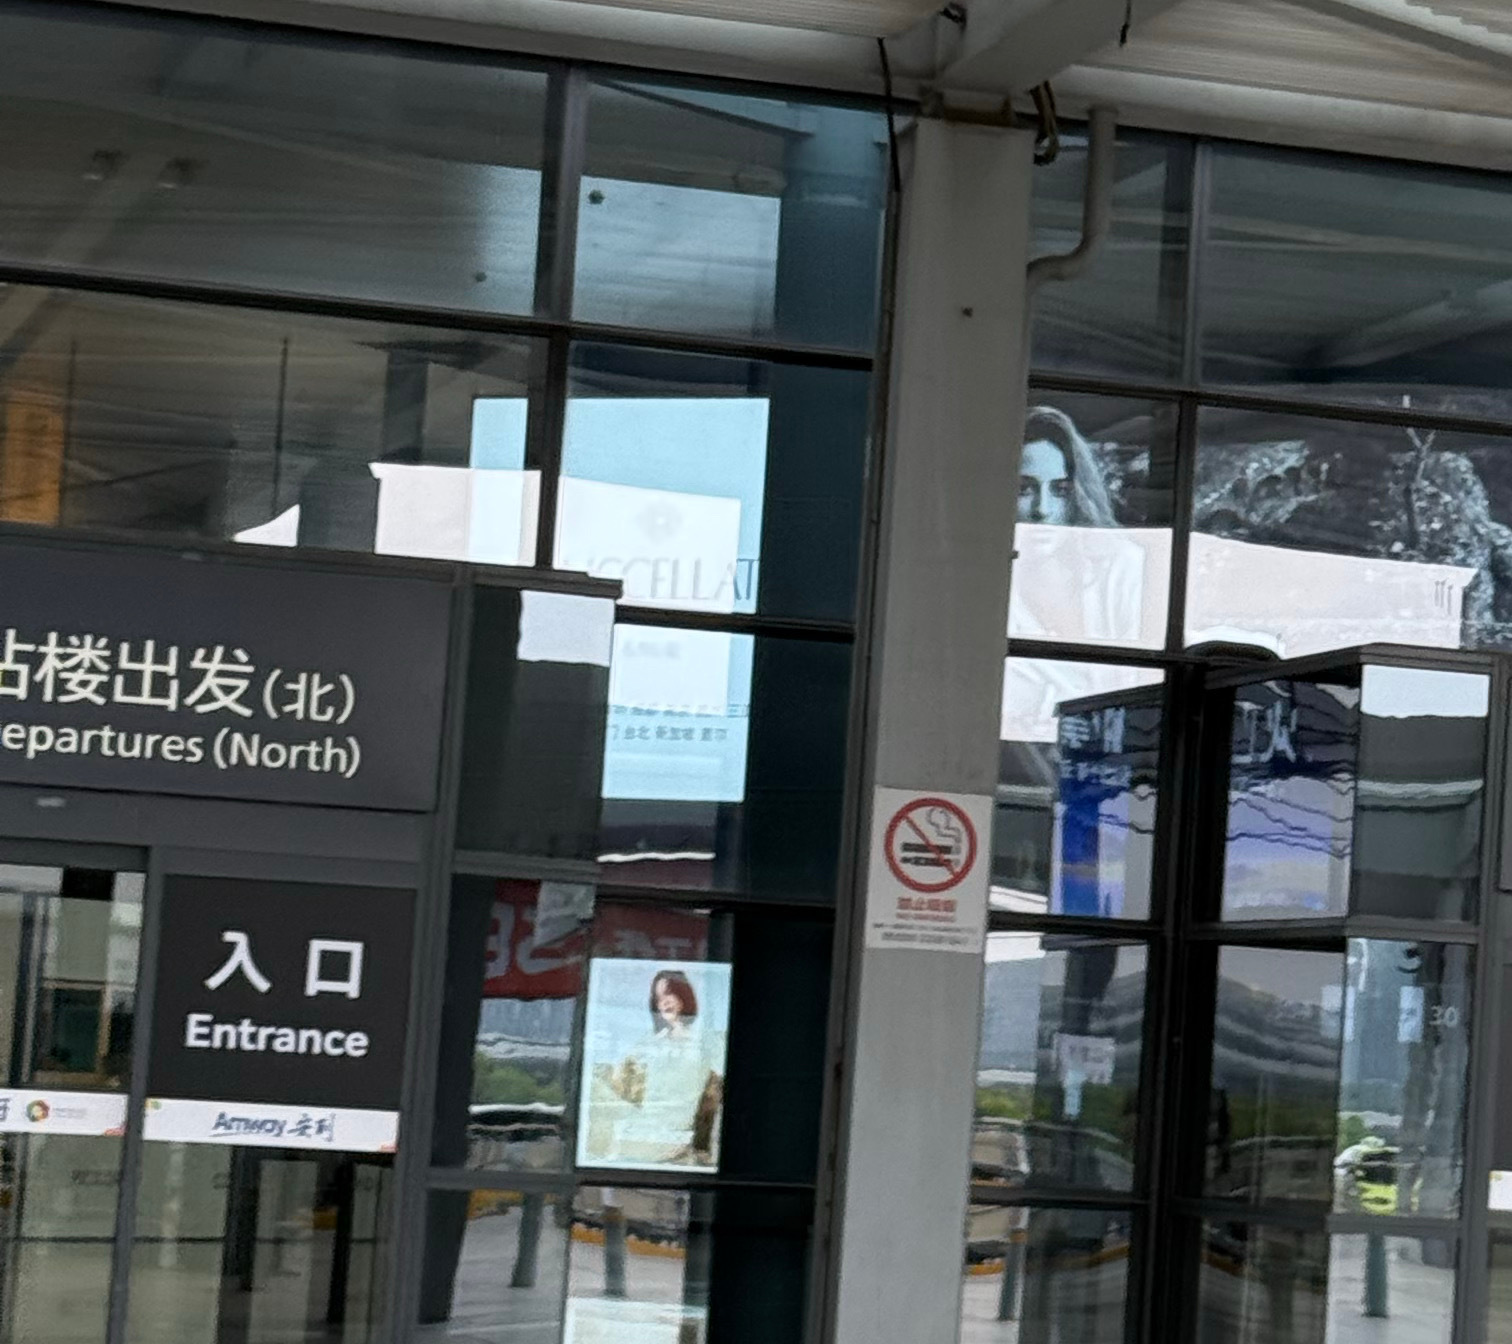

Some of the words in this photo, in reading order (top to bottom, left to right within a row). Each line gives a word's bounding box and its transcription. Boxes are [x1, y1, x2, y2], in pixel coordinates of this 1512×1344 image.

[213, 727, 362, 779] (North)
[204, 931, 365, 1000] 入口
[185, 1012, 371, 1058] Entrance
[210, 1111, 287, 1137] Amway
